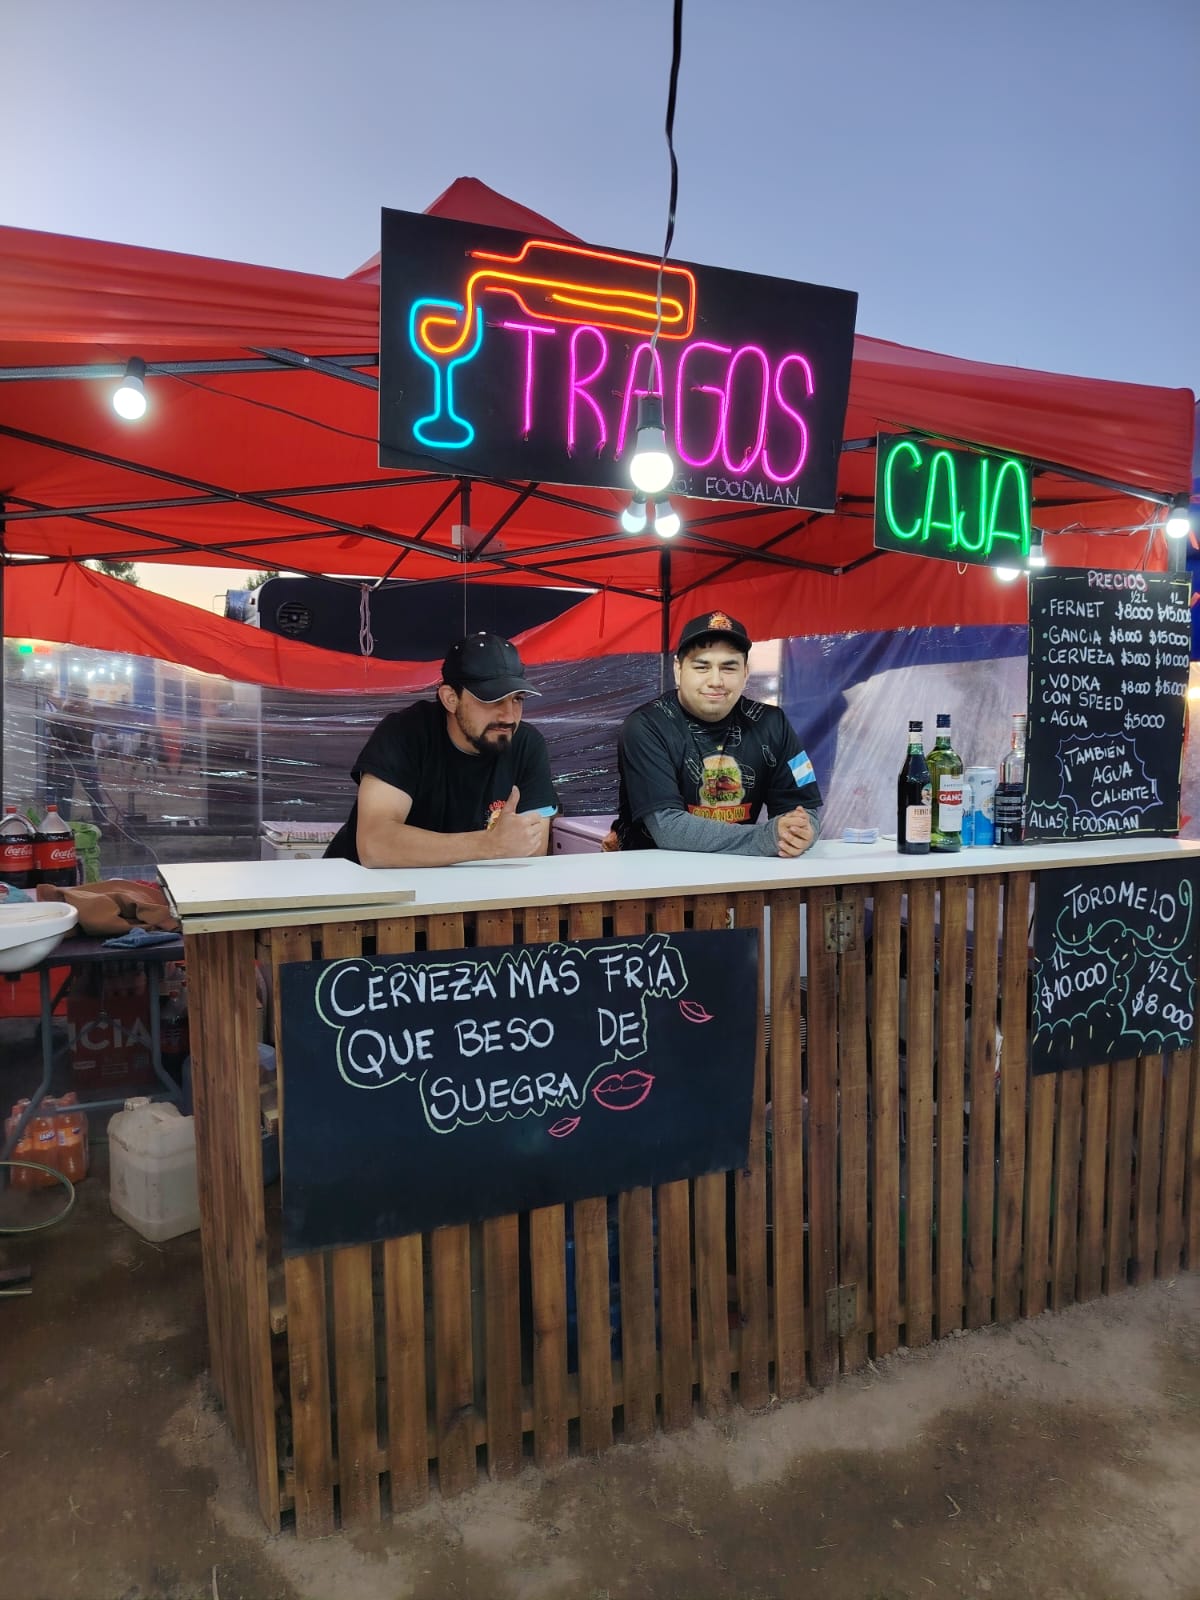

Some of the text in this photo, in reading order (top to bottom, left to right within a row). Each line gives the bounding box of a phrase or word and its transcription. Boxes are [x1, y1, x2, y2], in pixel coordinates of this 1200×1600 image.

[503, 322, 815, 483] TRAGOS
[705, 476, 800, 505] FOODALAN
[884, 441, 1031, 556] CAJA
[1088, 571, 1146, 591] PRECIOS
[1050, 599, 1104, 619] FERNET
[1049, 625, 1102, 645] GANCIA
[1048, 646, 1115, 666] CERVEZA
[1049, 673, 1101, 692] VODKA
[1042, 690, 1124, 711] CON SPEED
[1050, 710, 1088, 728] AGUA
[1091, 761, 1133, 787] AGUA
[1029, 810, 1139, 832] ALIAS FOODALAN
[1051, 952, 1070, 971] 1L
[330, 966, 496, 1017] CERVEZA
[599, 942, 676, 993] FRÍA
[347, 1007, 641, 1078] QUE BESO DE
[430, 1071, 578, 1120] SUEGRA
